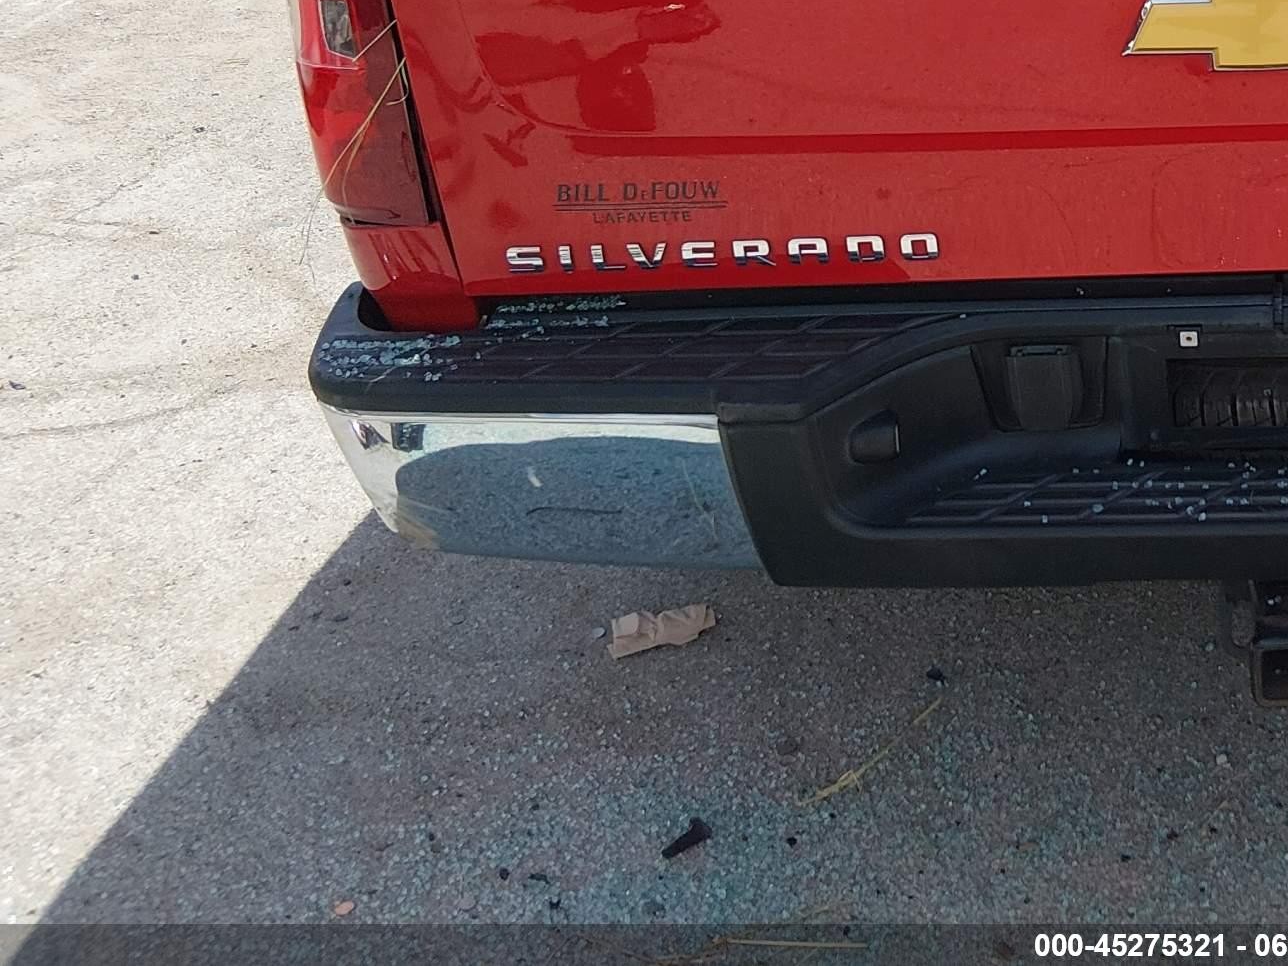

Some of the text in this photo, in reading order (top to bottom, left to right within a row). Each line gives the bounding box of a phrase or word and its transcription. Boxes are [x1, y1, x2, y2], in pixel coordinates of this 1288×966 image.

[557, 183, 610, 203] BILL
[593, 210, 693, 224] LAFAYETTE
[505, 232, 941, 274] SILVERADO
